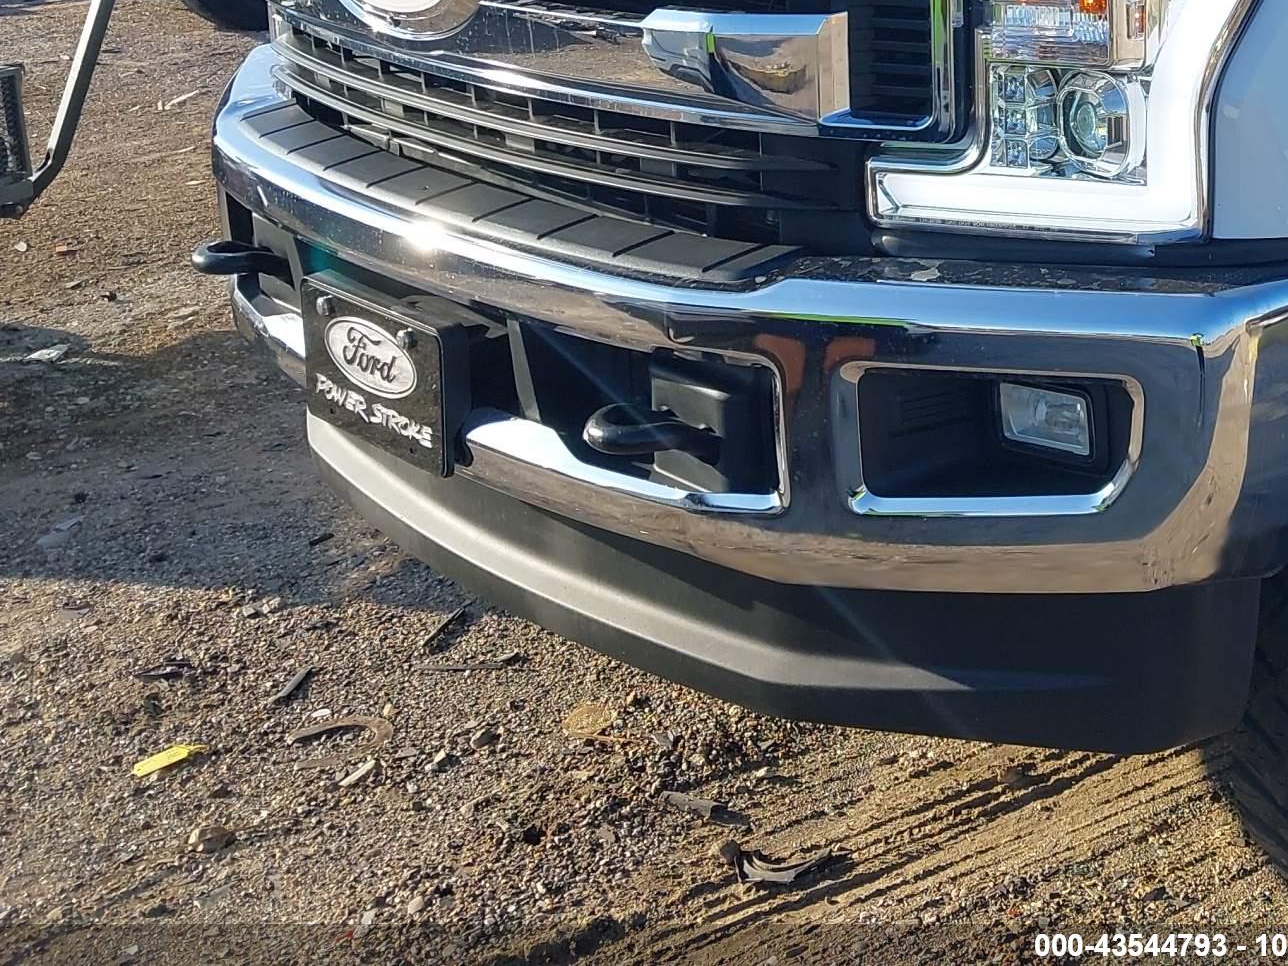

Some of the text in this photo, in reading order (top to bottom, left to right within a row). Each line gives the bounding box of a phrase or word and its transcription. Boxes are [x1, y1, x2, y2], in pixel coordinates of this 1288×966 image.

[342, 326, 397, 384] Ford
[315, 372, 433, 449] POWER STROKE
